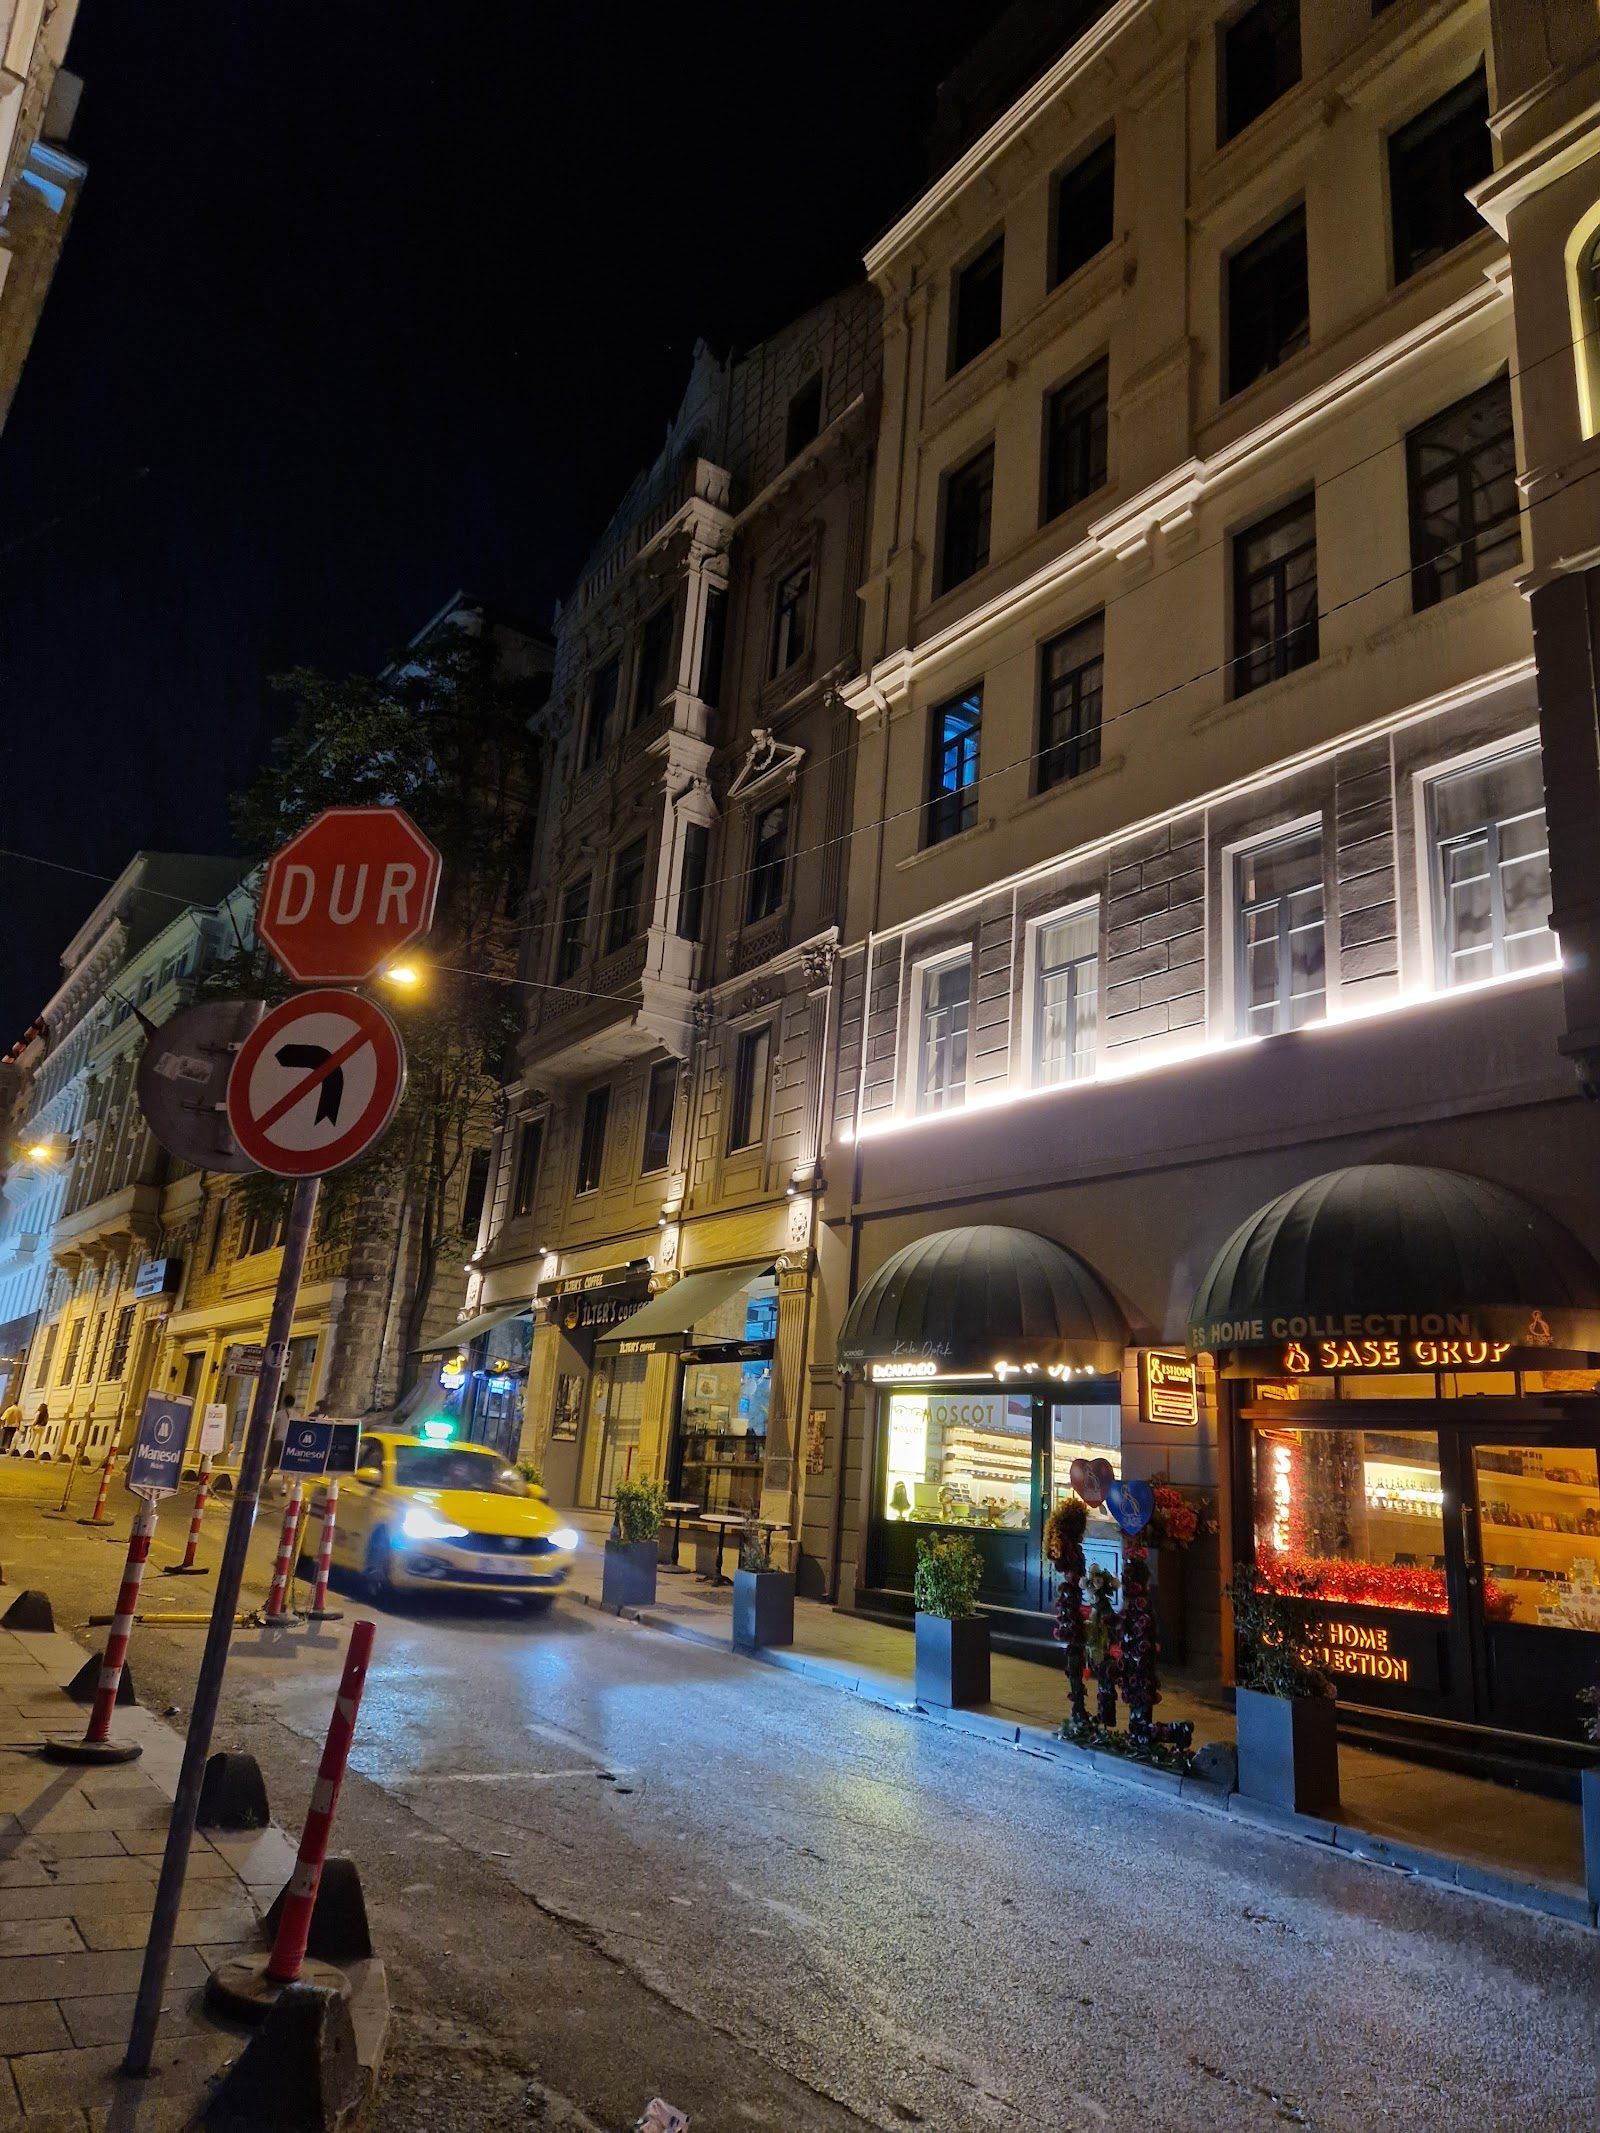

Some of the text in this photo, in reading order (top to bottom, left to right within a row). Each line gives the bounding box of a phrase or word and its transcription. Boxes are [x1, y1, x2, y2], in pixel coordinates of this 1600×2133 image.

[276, 862, 417, 926] DUR
[584, 1273, 604, 1289] COFFEE
[1211, 1319, 1265, 1344] HOME
[1271, 1314, 1471, 1339] COLLECTION
[1320, 1340, 1511, 1369] SASE GRUP
[922, 1403, 994, 1425] MOSCOT
[138, 1443, 181, 1464] Manesol
[286, 1447, 326, 1460] Manesol
[1329, 1622, 1388, 1652] HOME
